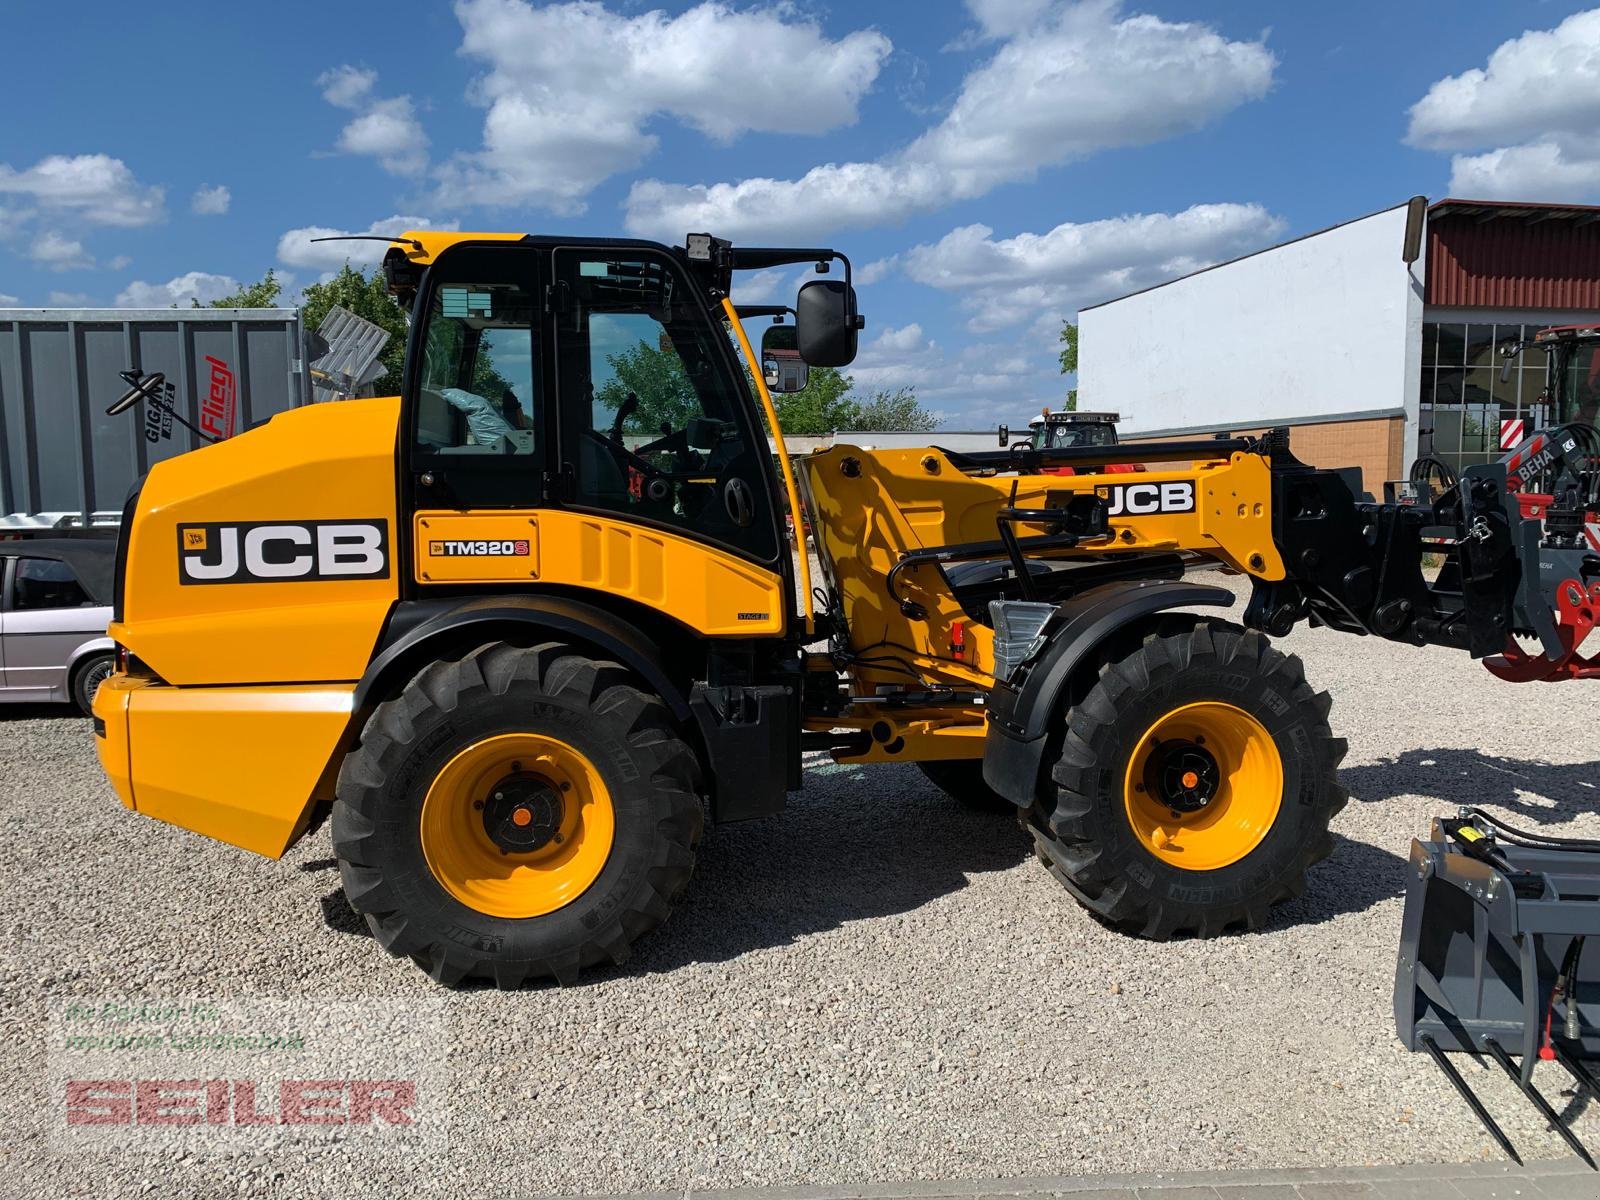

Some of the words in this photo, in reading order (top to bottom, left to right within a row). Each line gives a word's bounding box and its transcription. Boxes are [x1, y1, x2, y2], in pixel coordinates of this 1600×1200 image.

[201, 355, 232, 436] Fliegl
[1518, 449, 1554, 481] BEHA
[1108, 482, 1194, 515] JCB
[184, 524, 384, 579] JCB
[445, 541, 528, 555] TM320S
